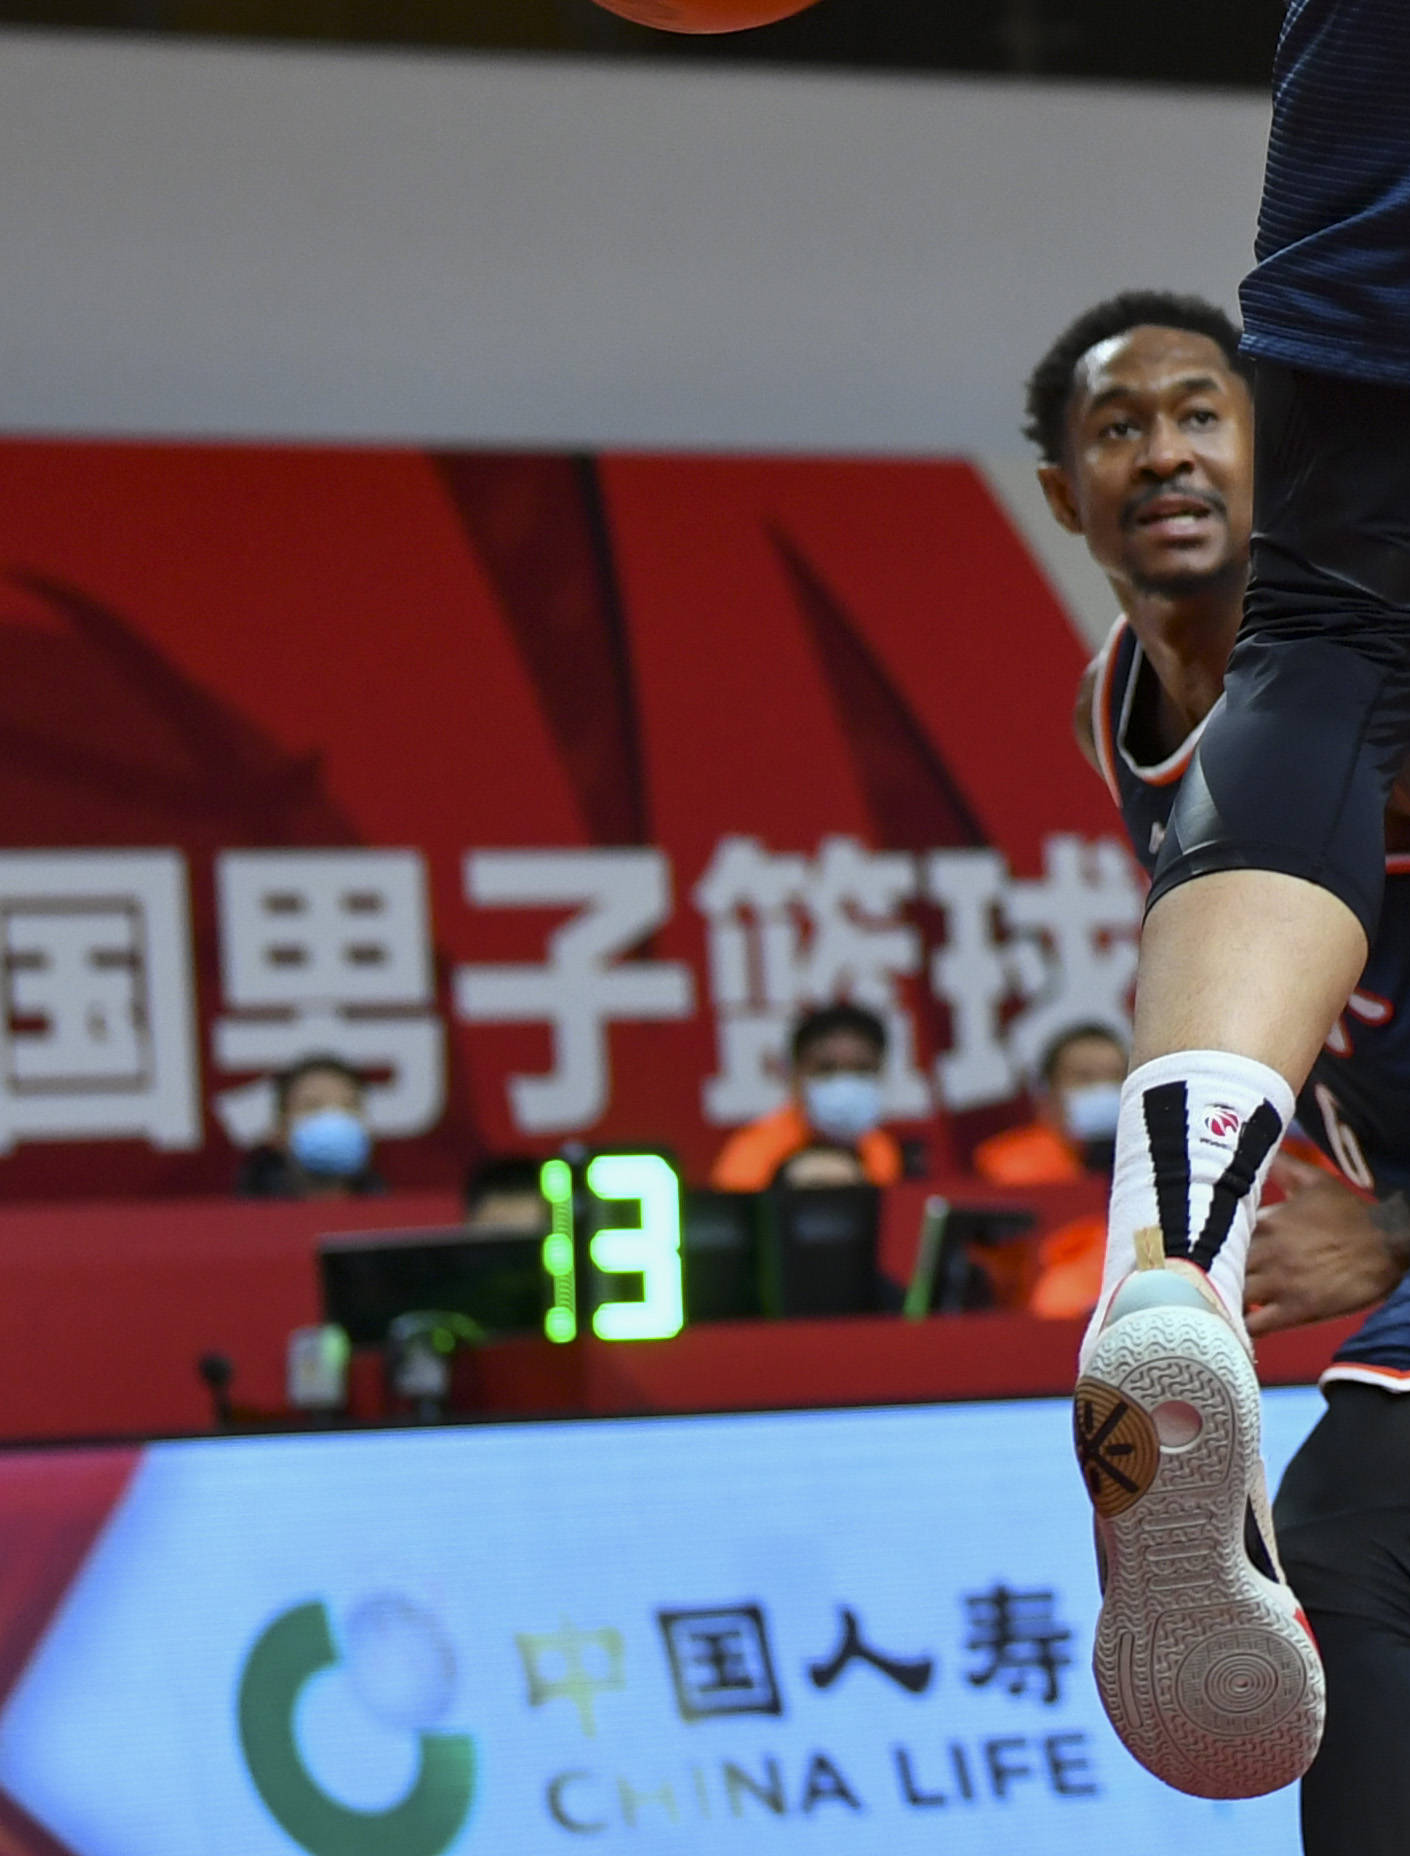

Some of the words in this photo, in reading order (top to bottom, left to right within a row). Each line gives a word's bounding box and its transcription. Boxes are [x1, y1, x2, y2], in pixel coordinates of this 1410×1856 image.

[540, 1153, 685, 1344] 13
[514, 1580, 1074, 1738] 中国人寿
[545, 1752, 864, 1835] CHINA
[892, 1732, 1101, 1809] LIFE
